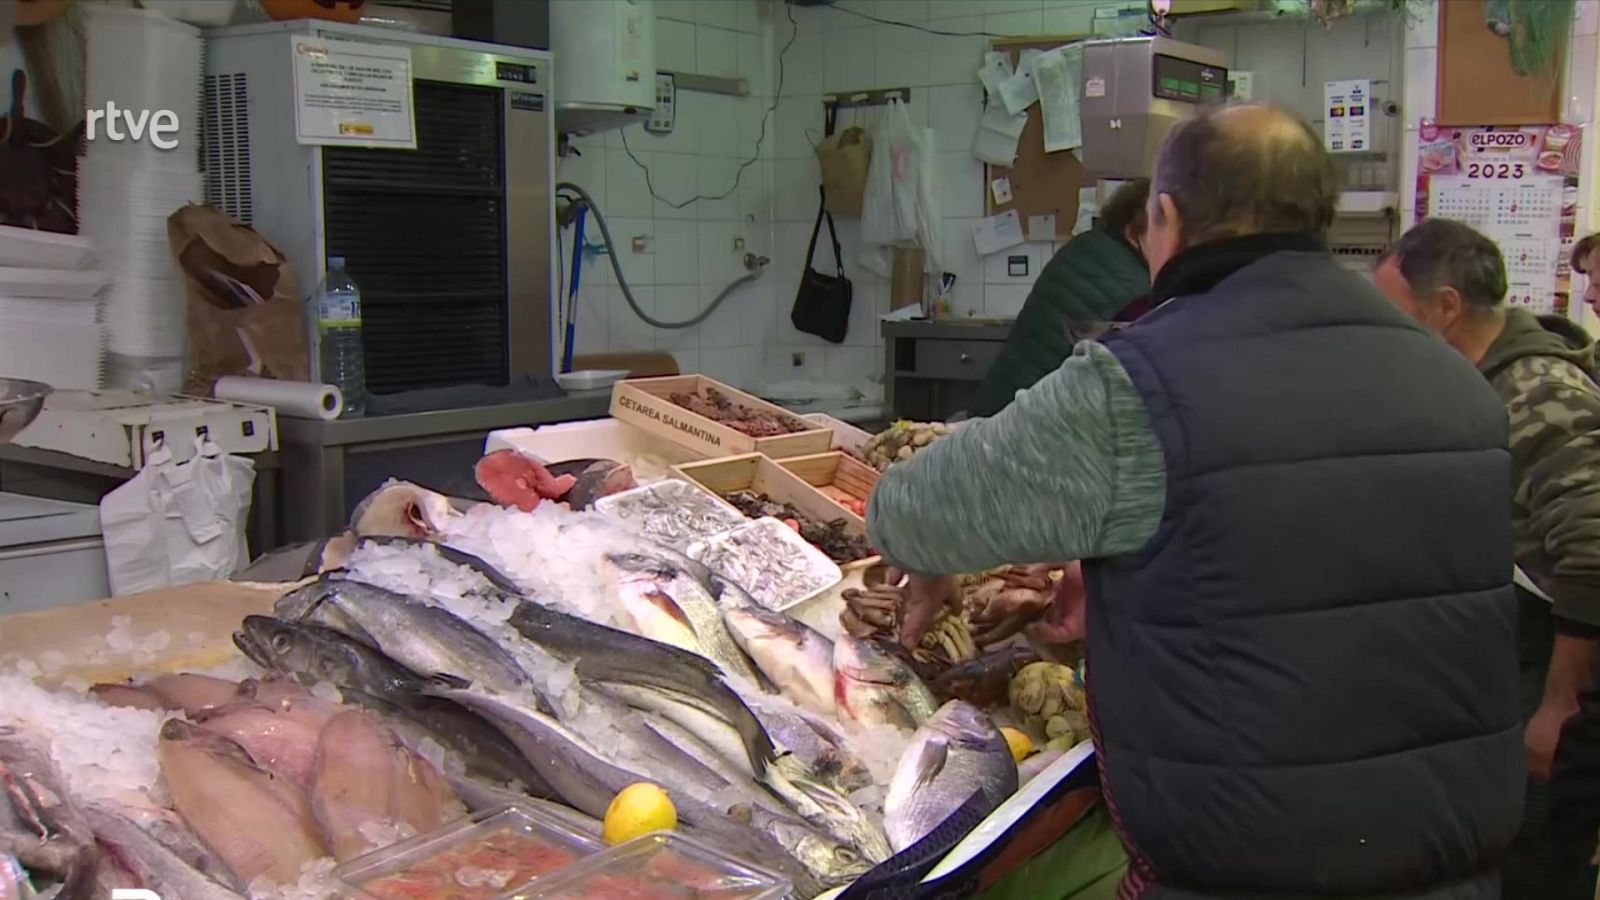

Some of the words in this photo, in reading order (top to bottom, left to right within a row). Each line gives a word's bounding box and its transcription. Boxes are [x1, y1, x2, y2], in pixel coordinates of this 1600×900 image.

[1468, 163, 1524, 179] 2023
[619, 396, 661, 421] CETAREA
[662, 414, 721, 447] SALMANTINA
